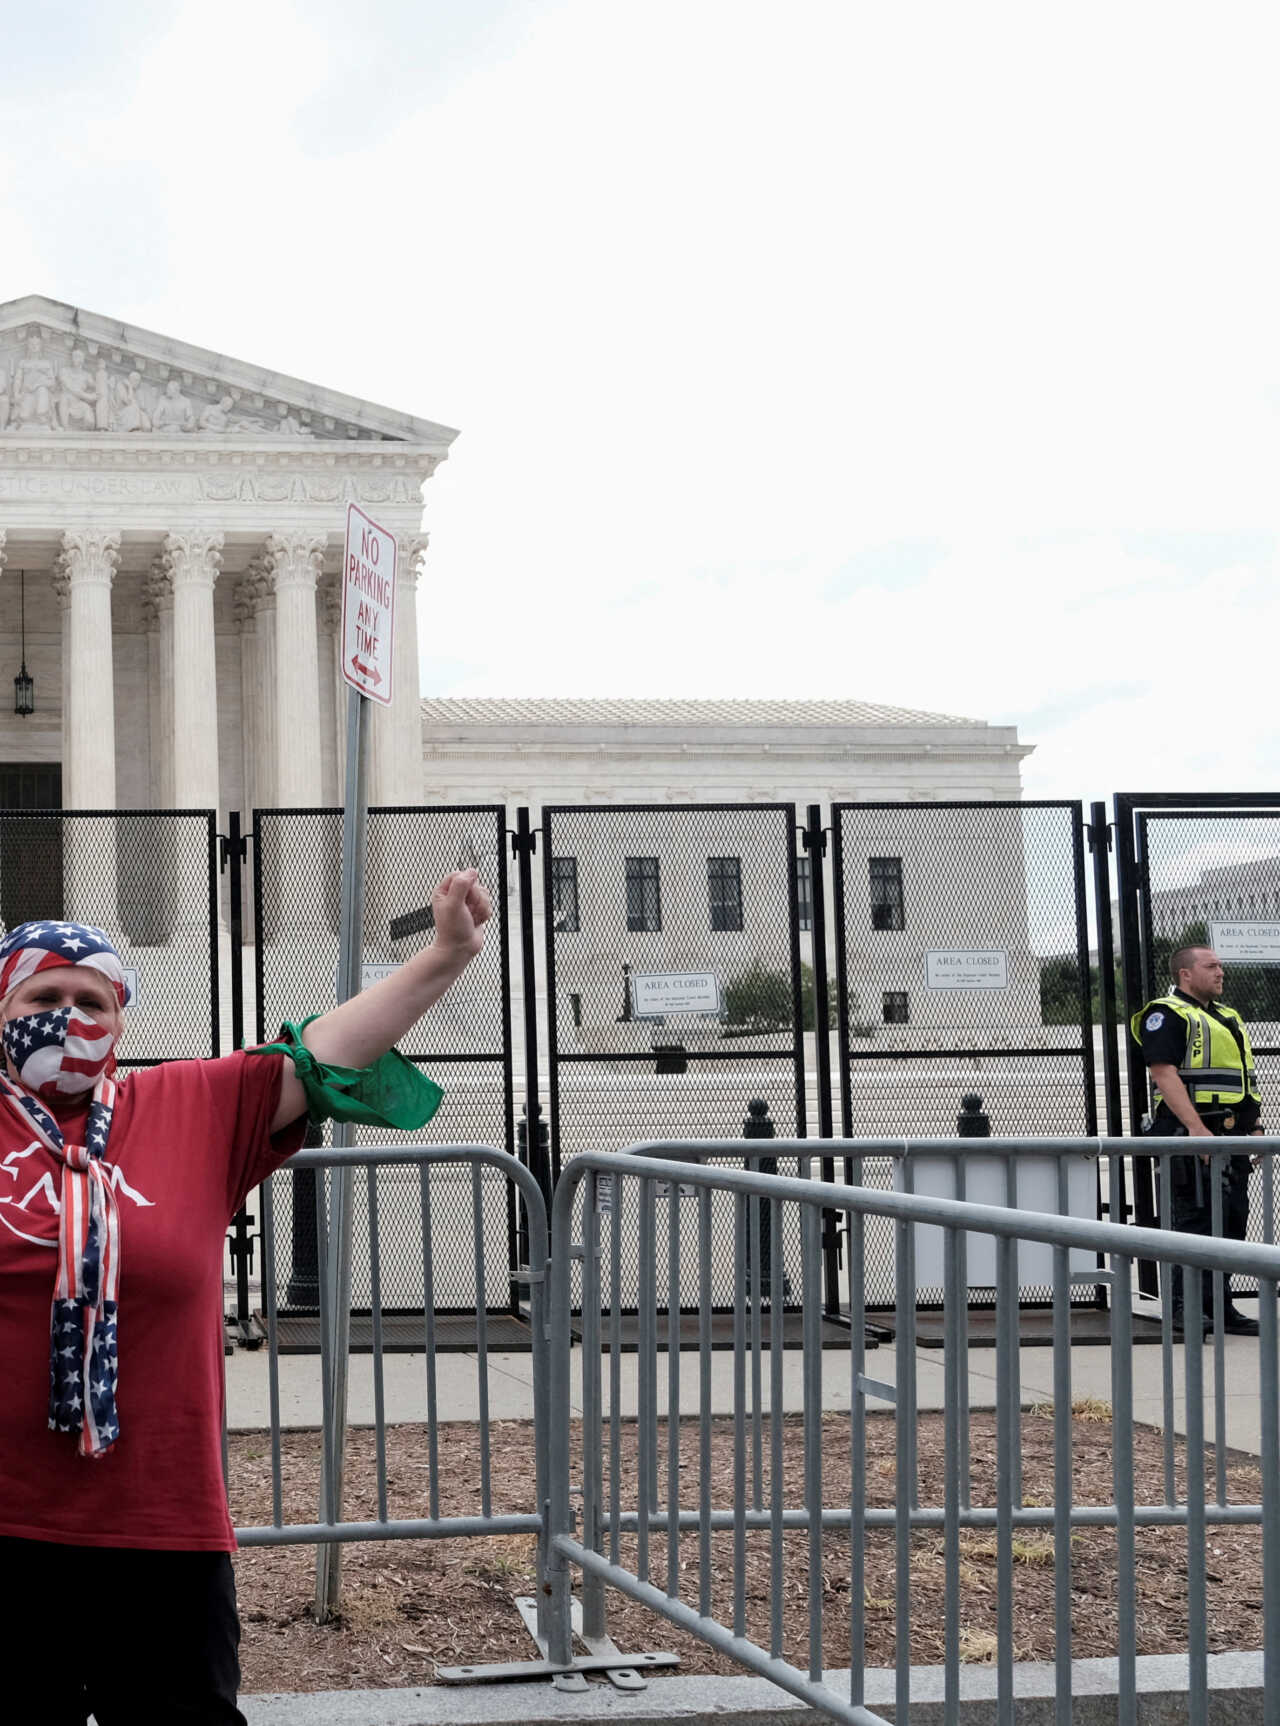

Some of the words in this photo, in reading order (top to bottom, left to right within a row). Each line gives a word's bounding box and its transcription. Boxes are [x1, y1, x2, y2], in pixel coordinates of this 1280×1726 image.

[60, 477, 137, 494] UNDER
[142, 478, 183, 494] LAW
[361, 527, 380, 567] NO
[348, 551, 391, 610] PARKING
[357, 599, 380, 633] ANY
[355, 624, 380, 661] TIME
[1220, 928, 1244, 937] AREA
[1247, 928, 1280, 937] CLOSED
[936, 957, 962, 966] AREA
[966, 957, 1000, 966] CLOSED
[645, 981, 669, 990] AREA
[672, 980, 708, 989] CLOSED
